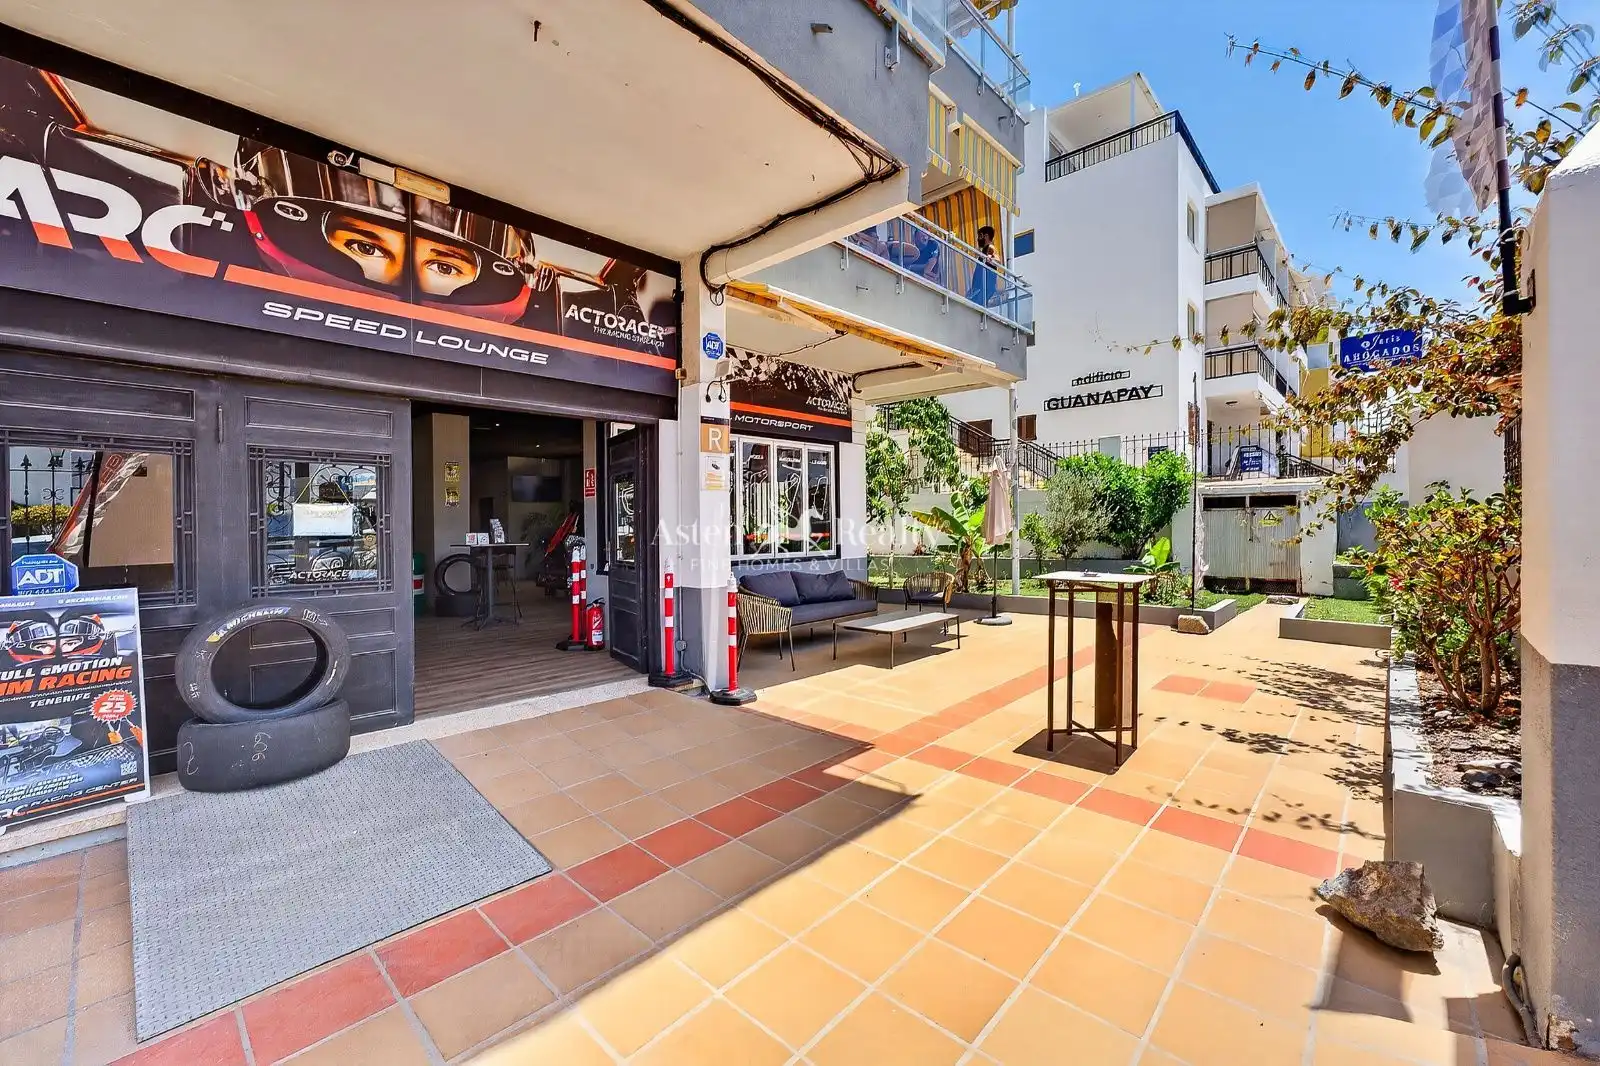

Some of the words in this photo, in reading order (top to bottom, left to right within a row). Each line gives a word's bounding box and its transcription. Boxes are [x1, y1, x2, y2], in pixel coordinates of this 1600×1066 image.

[262, 301, 407, 339] SPEED
[415, 330, 550, 365] LOUNGE
[564, 303, 665, 341] ACTORACER
[1343, 343, 1420, 364] ABOGADOS
[1046, 384, 1154, 411] GUANAPAY
[734, 414, 814, 431] MOTORSPORT
[708, 427, 723, 451] R
[18, 568, 64, 587] ADT
[0, 668, 35, 681] ULL
[40, 657, 122, 672] eMOTION
[35, 666, 132, 692] RACING
[30, 692, 91, 708] TENERIFE
[98, 701, 127, 713] 25
